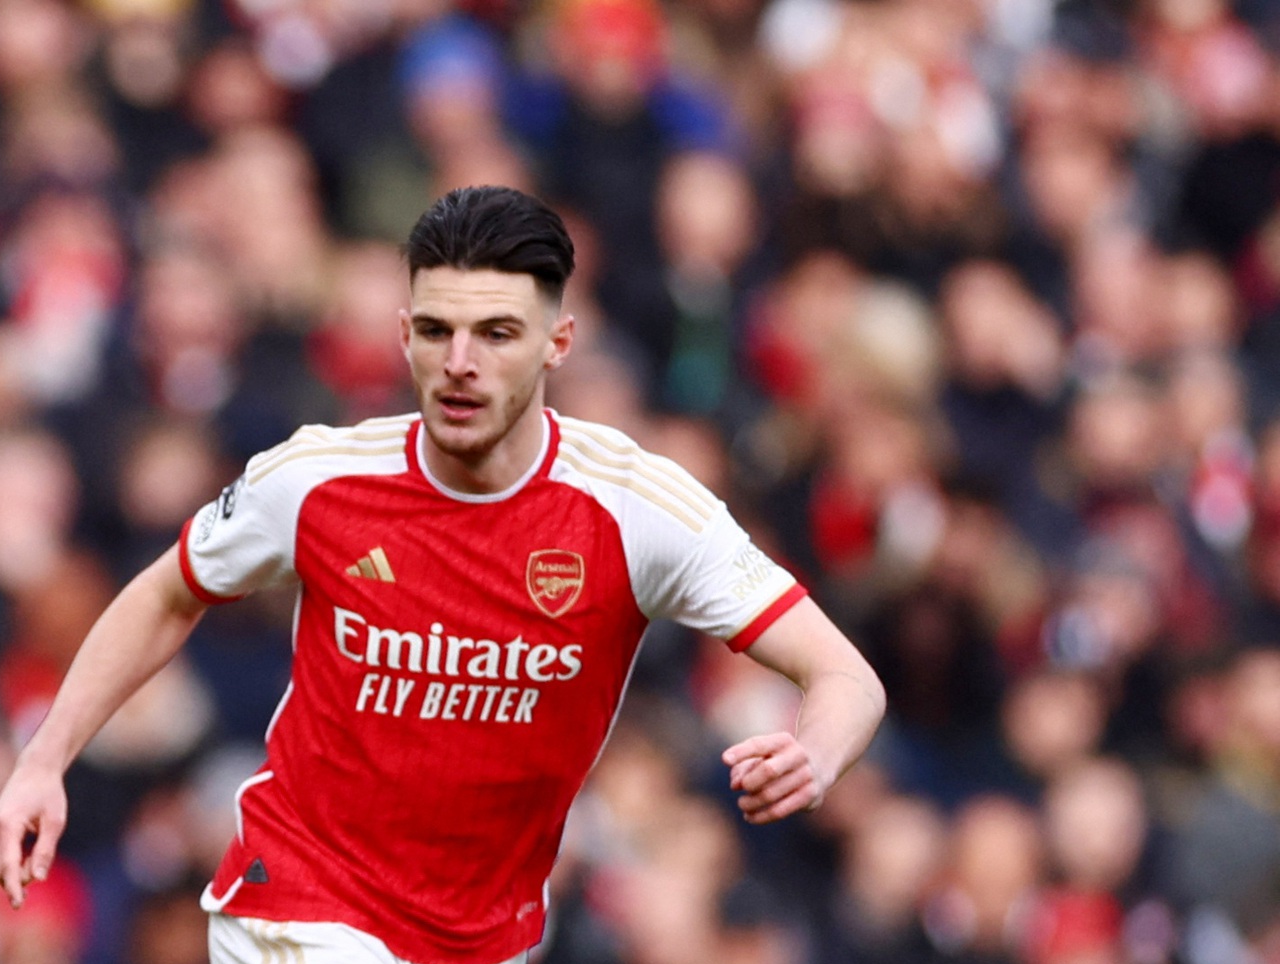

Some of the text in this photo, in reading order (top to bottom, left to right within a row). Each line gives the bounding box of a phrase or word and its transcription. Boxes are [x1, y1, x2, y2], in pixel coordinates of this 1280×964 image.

[333, 605, 583, 682] Emirates
[355, 672, 540, 723] FLY BETTER
